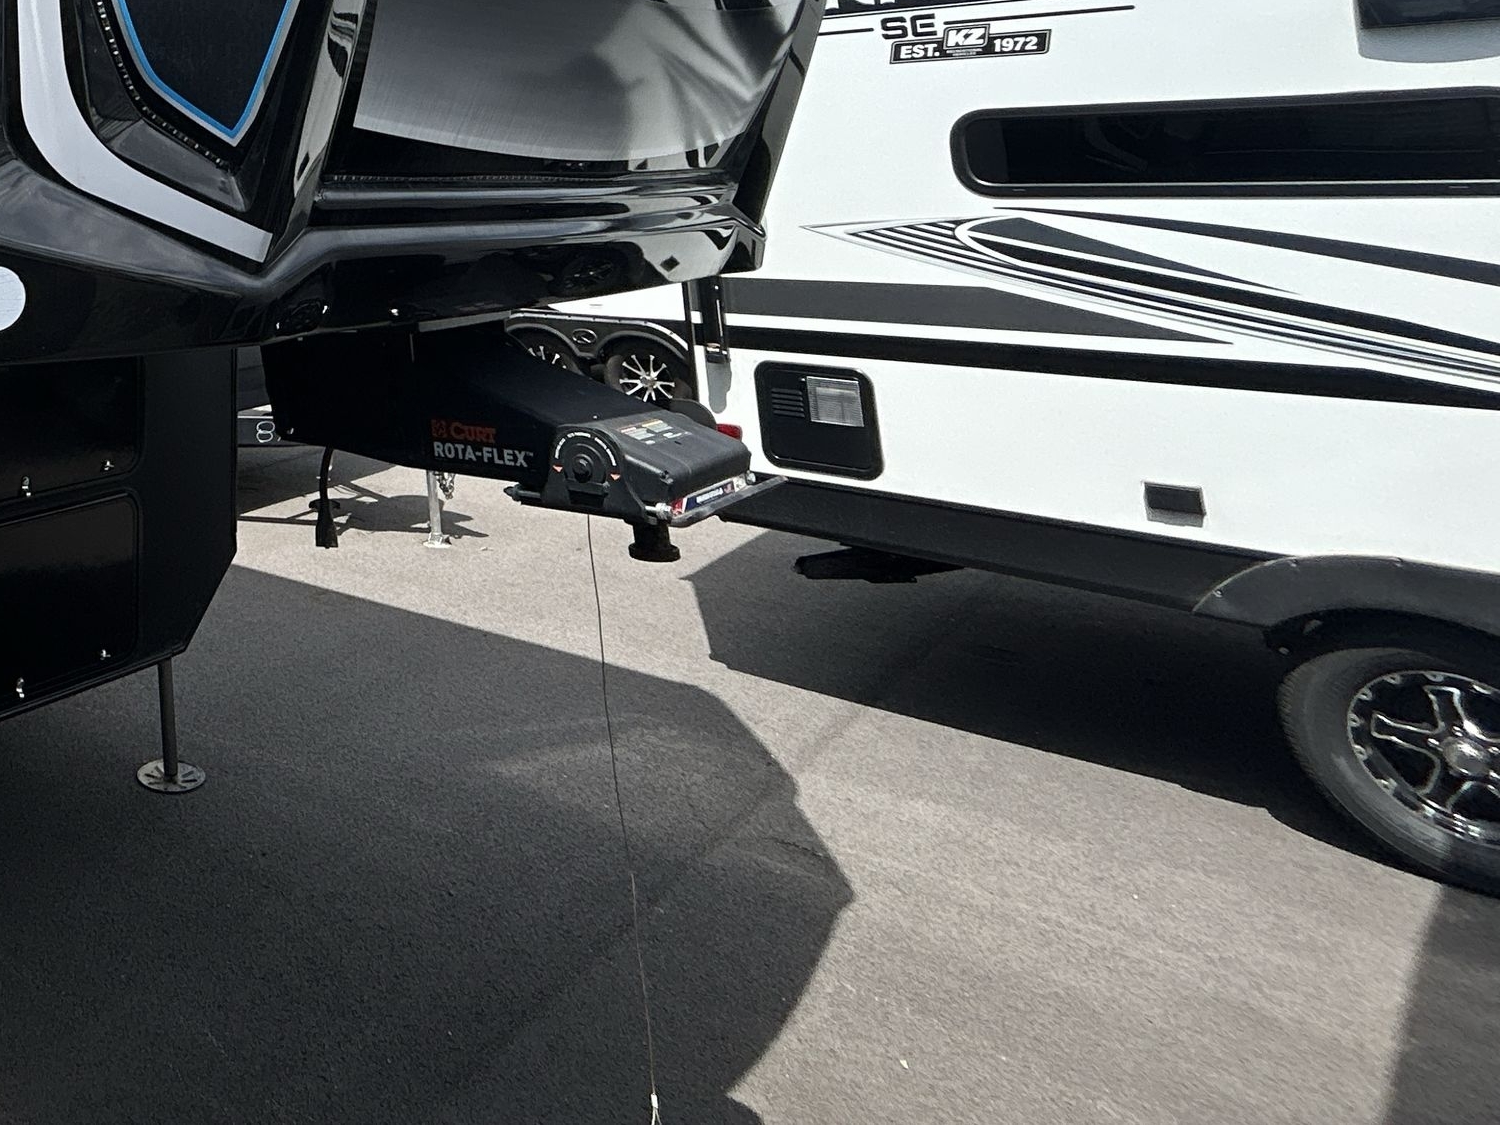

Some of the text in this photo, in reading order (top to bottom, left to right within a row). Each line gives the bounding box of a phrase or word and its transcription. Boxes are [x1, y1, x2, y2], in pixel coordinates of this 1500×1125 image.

[880, 13, 938, 40] SE
[900, 43, 940, 59] EST.
[946, 27, 986, 47] KZ
[993, 36, 1038, 52] 1972
